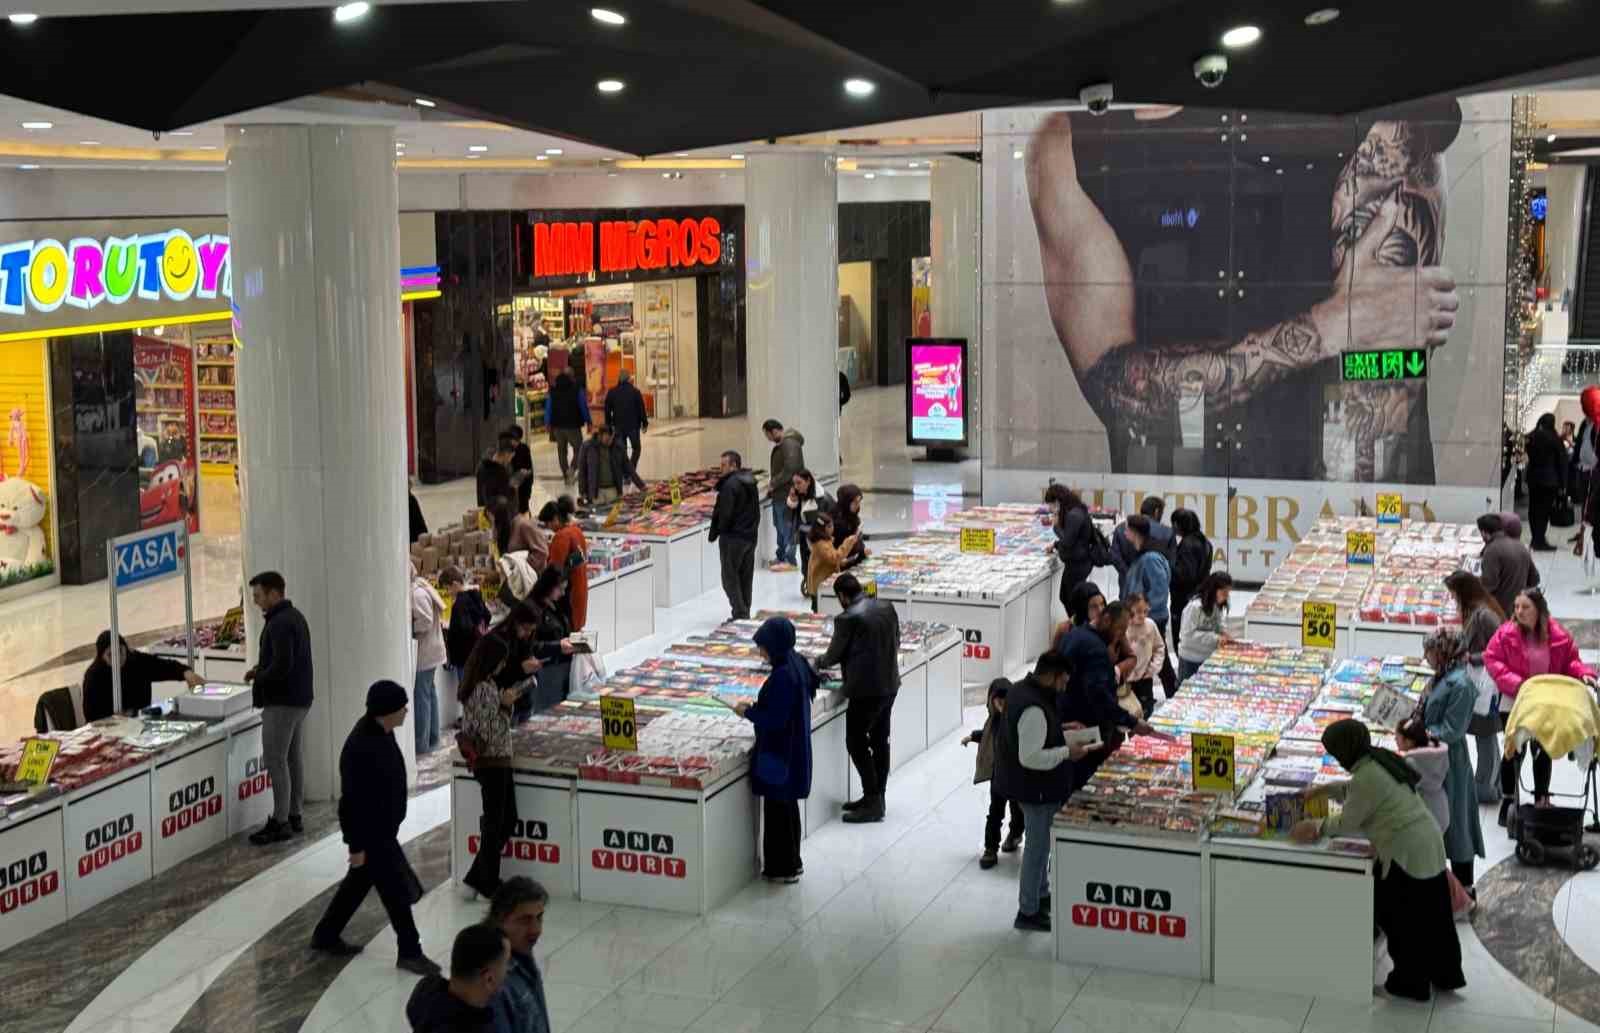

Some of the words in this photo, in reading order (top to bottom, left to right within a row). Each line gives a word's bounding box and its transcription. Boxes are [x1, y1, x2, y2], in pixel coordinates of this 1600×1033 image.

[534, 222, 594, 278] MM
[0, 231, 232, 310] TORUTOY
[1345, 353, 1379, 367] EXIT
[114, 535, 175, 577] KASA
[1352, 542, 1369, 554] 70
[1307, 620, 1331, 637] 50
[604, 718, 634, 737] 100
[1199, 756, 1228, 778] 50
[171, 778, 212, 810] ANA
[241, 772, 272, 798] YU
[163, 796, 220, 836] YURT
[88, 815, 132, 849] ANA
[607, 831, 670, 852] ANA
[80, 833, 139, 875] YURT
[595, 851, 682, 876] YURT
[0, 853, 45, 887] NA
[1089, 883, 1167, 910] ANA
[1076, 905, 1181, 936] YURT
